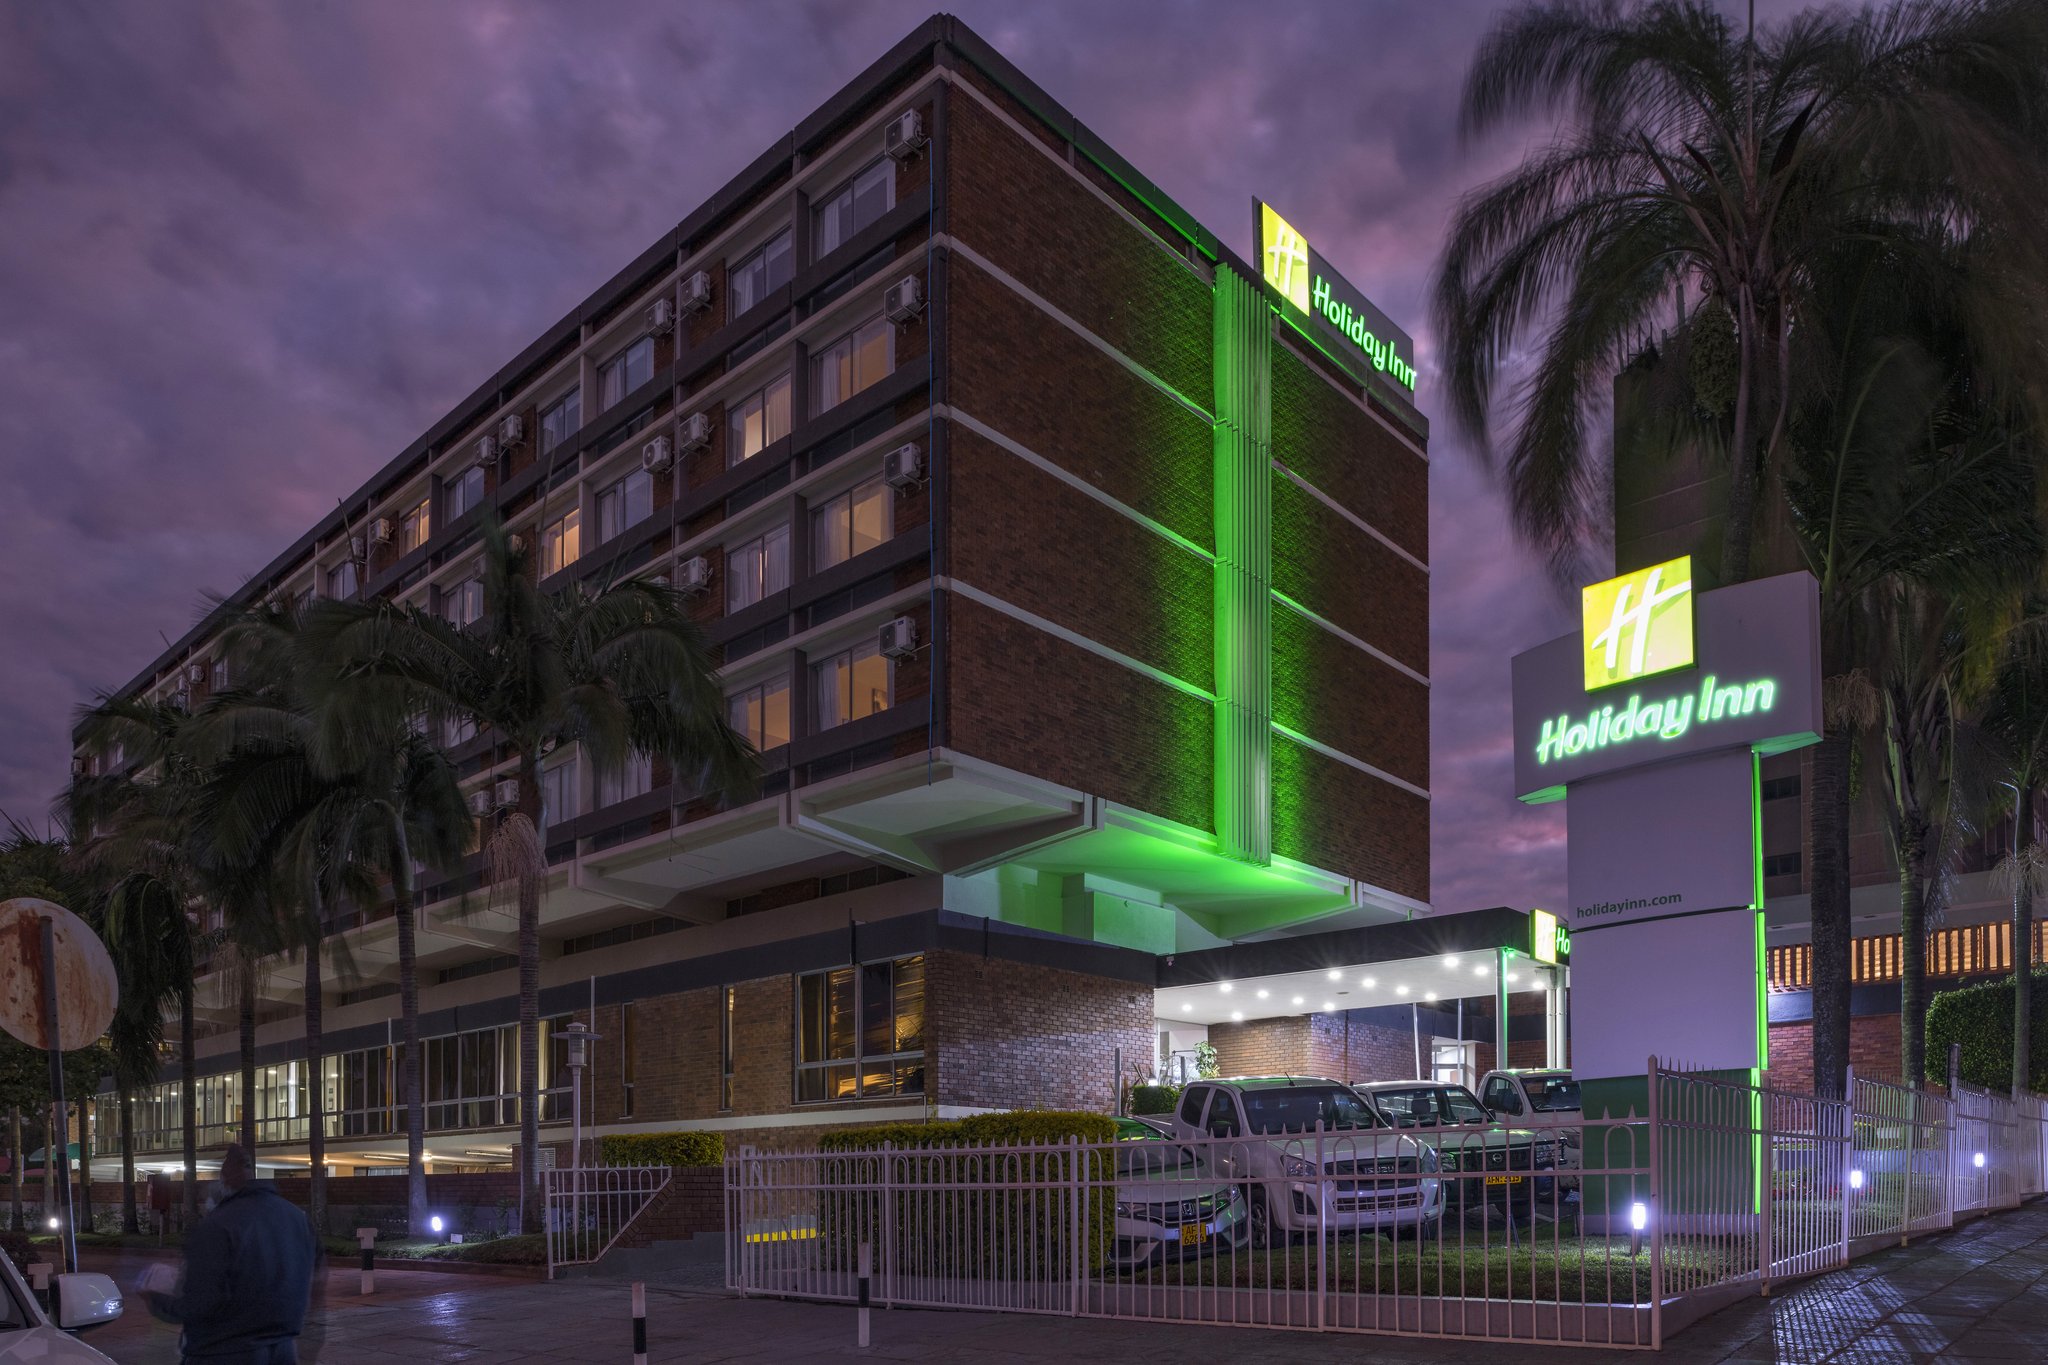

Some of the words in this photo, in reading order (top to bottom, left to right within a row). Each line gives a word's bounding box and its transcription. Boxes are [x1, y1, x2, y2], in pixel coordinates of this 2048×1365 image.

[1312, 274, 1386, 371] Holiday
[1388, 340, 1417, 391] Inn
[1536, 694, 1694, 764] Holiday
[1697, 675, 1775, 722] Inn
[1576, 893, 1682, 919] holidayinn.com
[1364, 1166, 1394, 1174] ISUZU
